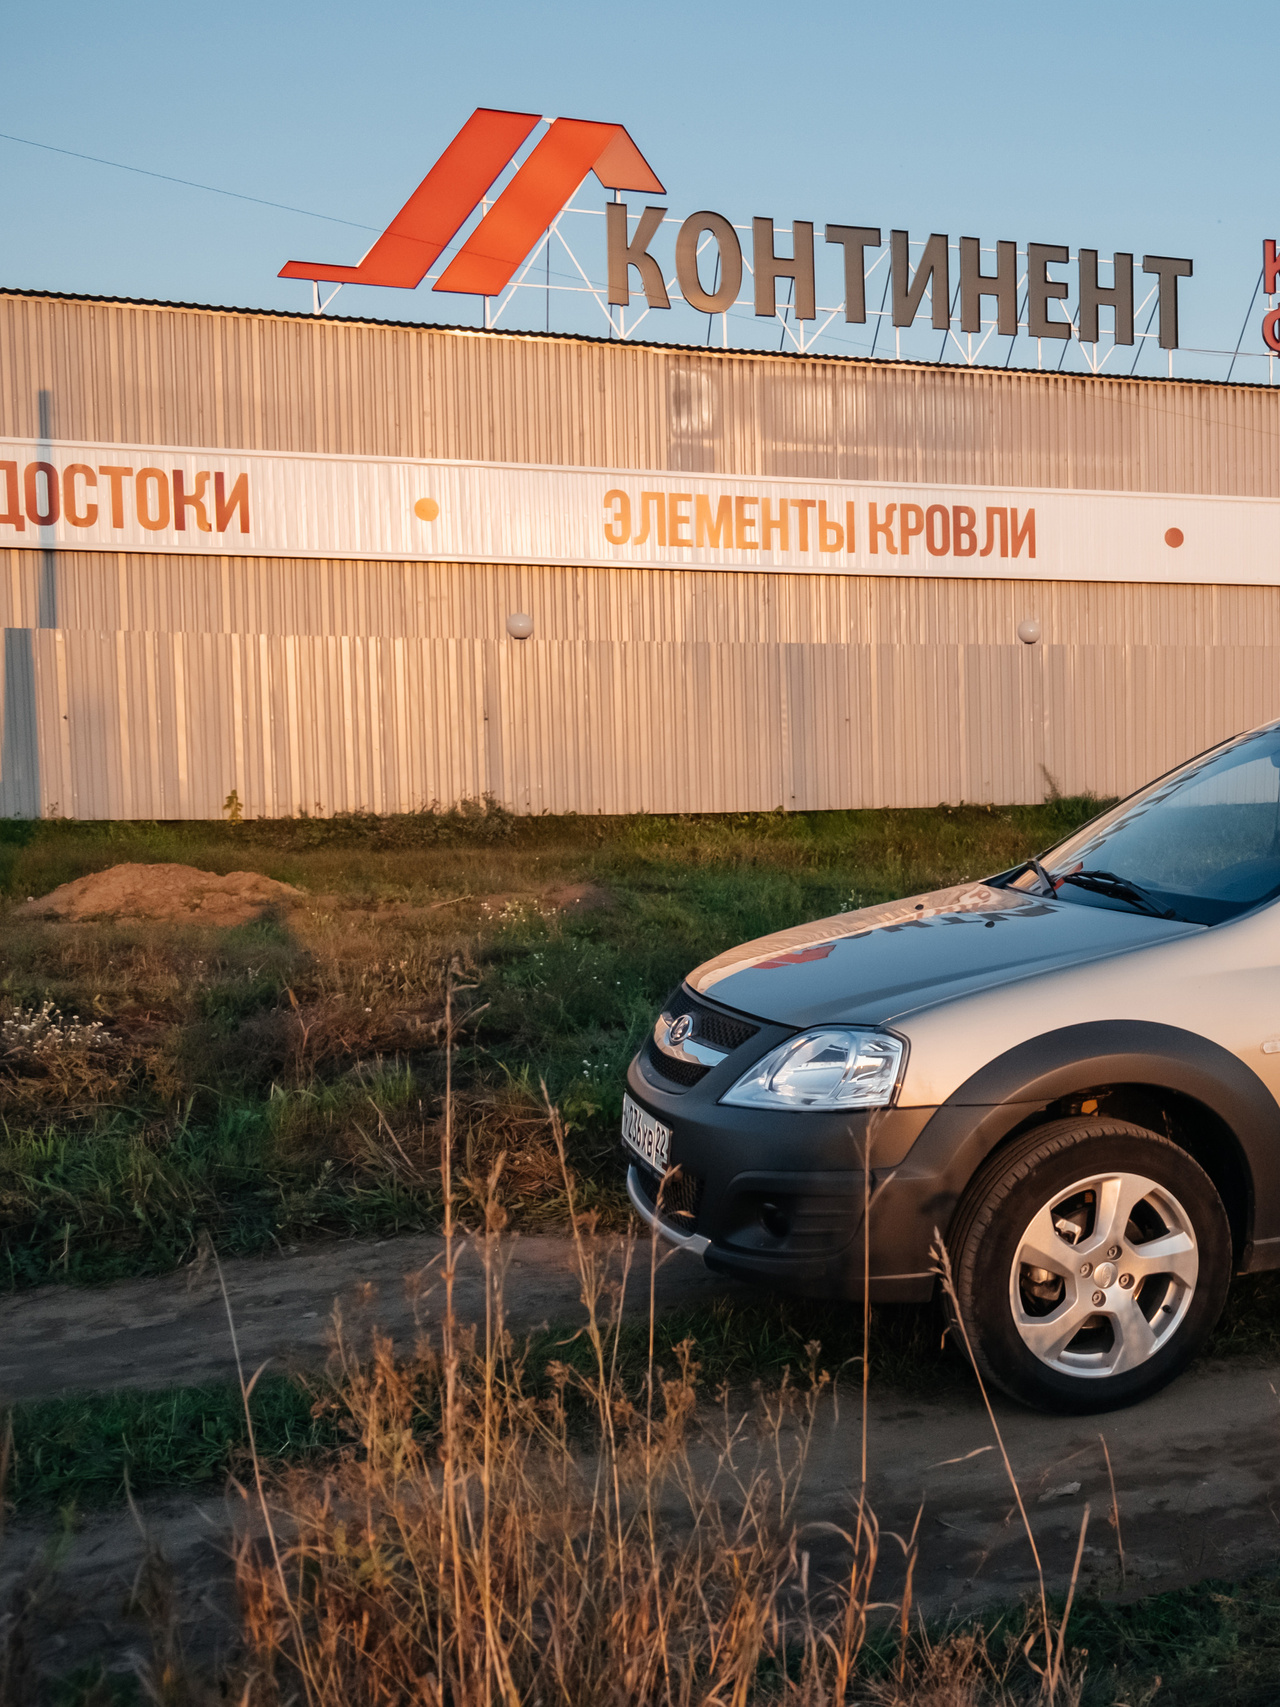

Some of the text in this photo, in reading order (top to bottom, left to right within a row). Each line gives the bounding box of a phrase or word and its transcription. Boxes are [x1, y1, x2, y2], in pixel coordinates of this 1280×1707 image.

[606, 202, 1193, 349] КОНТИНЕНТ
[603, 488, 1037, 558] ЭЛЕМЕНТЫ КРОВЛИ
